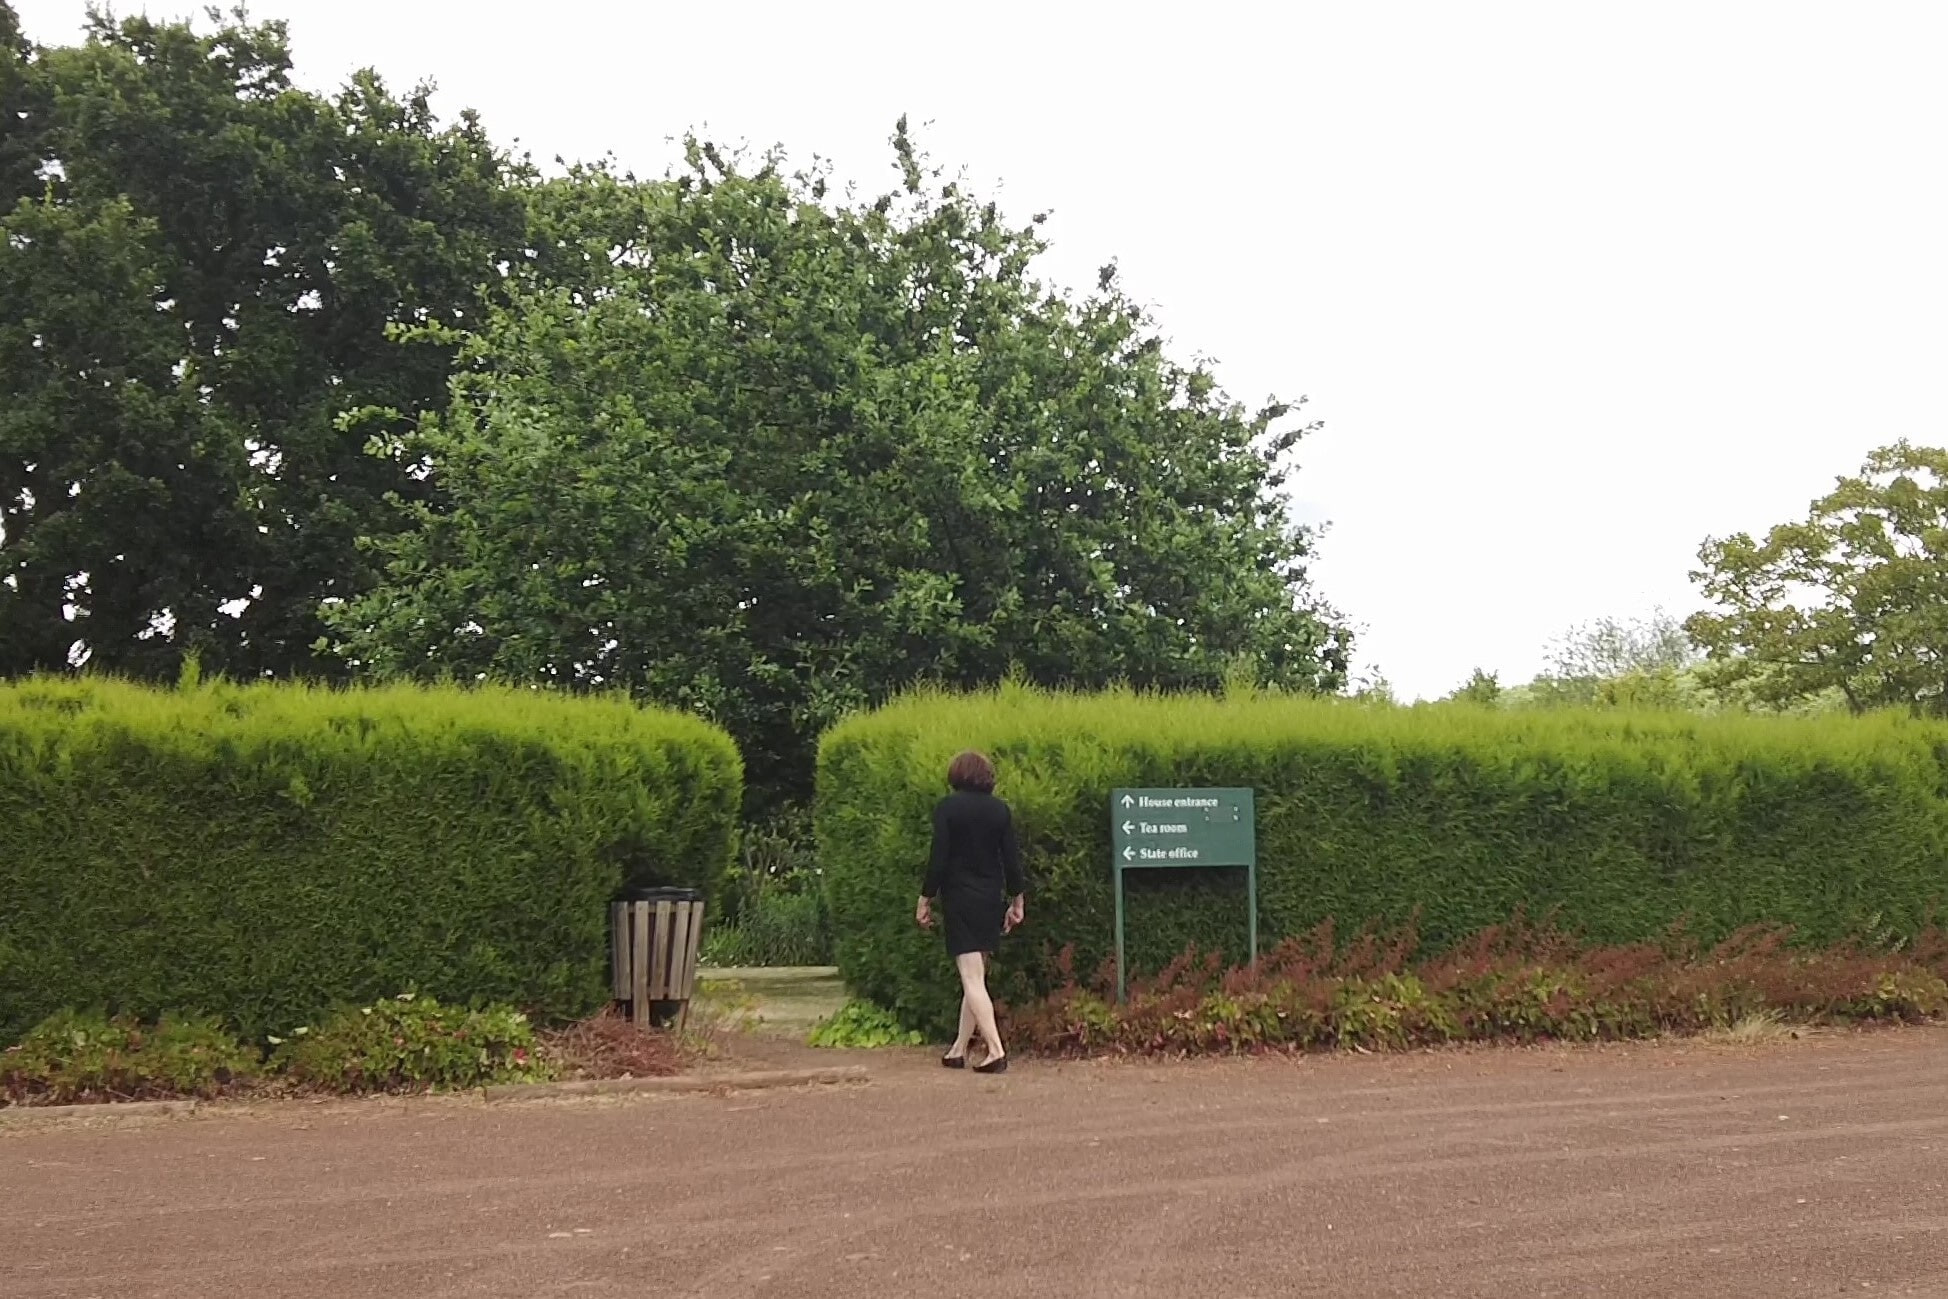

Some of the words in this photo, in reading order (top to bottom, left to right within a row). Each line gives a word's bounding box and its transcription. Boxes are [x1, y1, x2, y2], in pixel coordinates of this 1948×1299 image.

[1139, 796, 1173, 807] House
[1174, 797, 1219, 807] entrance
[1139, 821, 1158, 833] Tea
[1159, 823, 1188, 833] room
[1167, 846, 1199, 859] office
